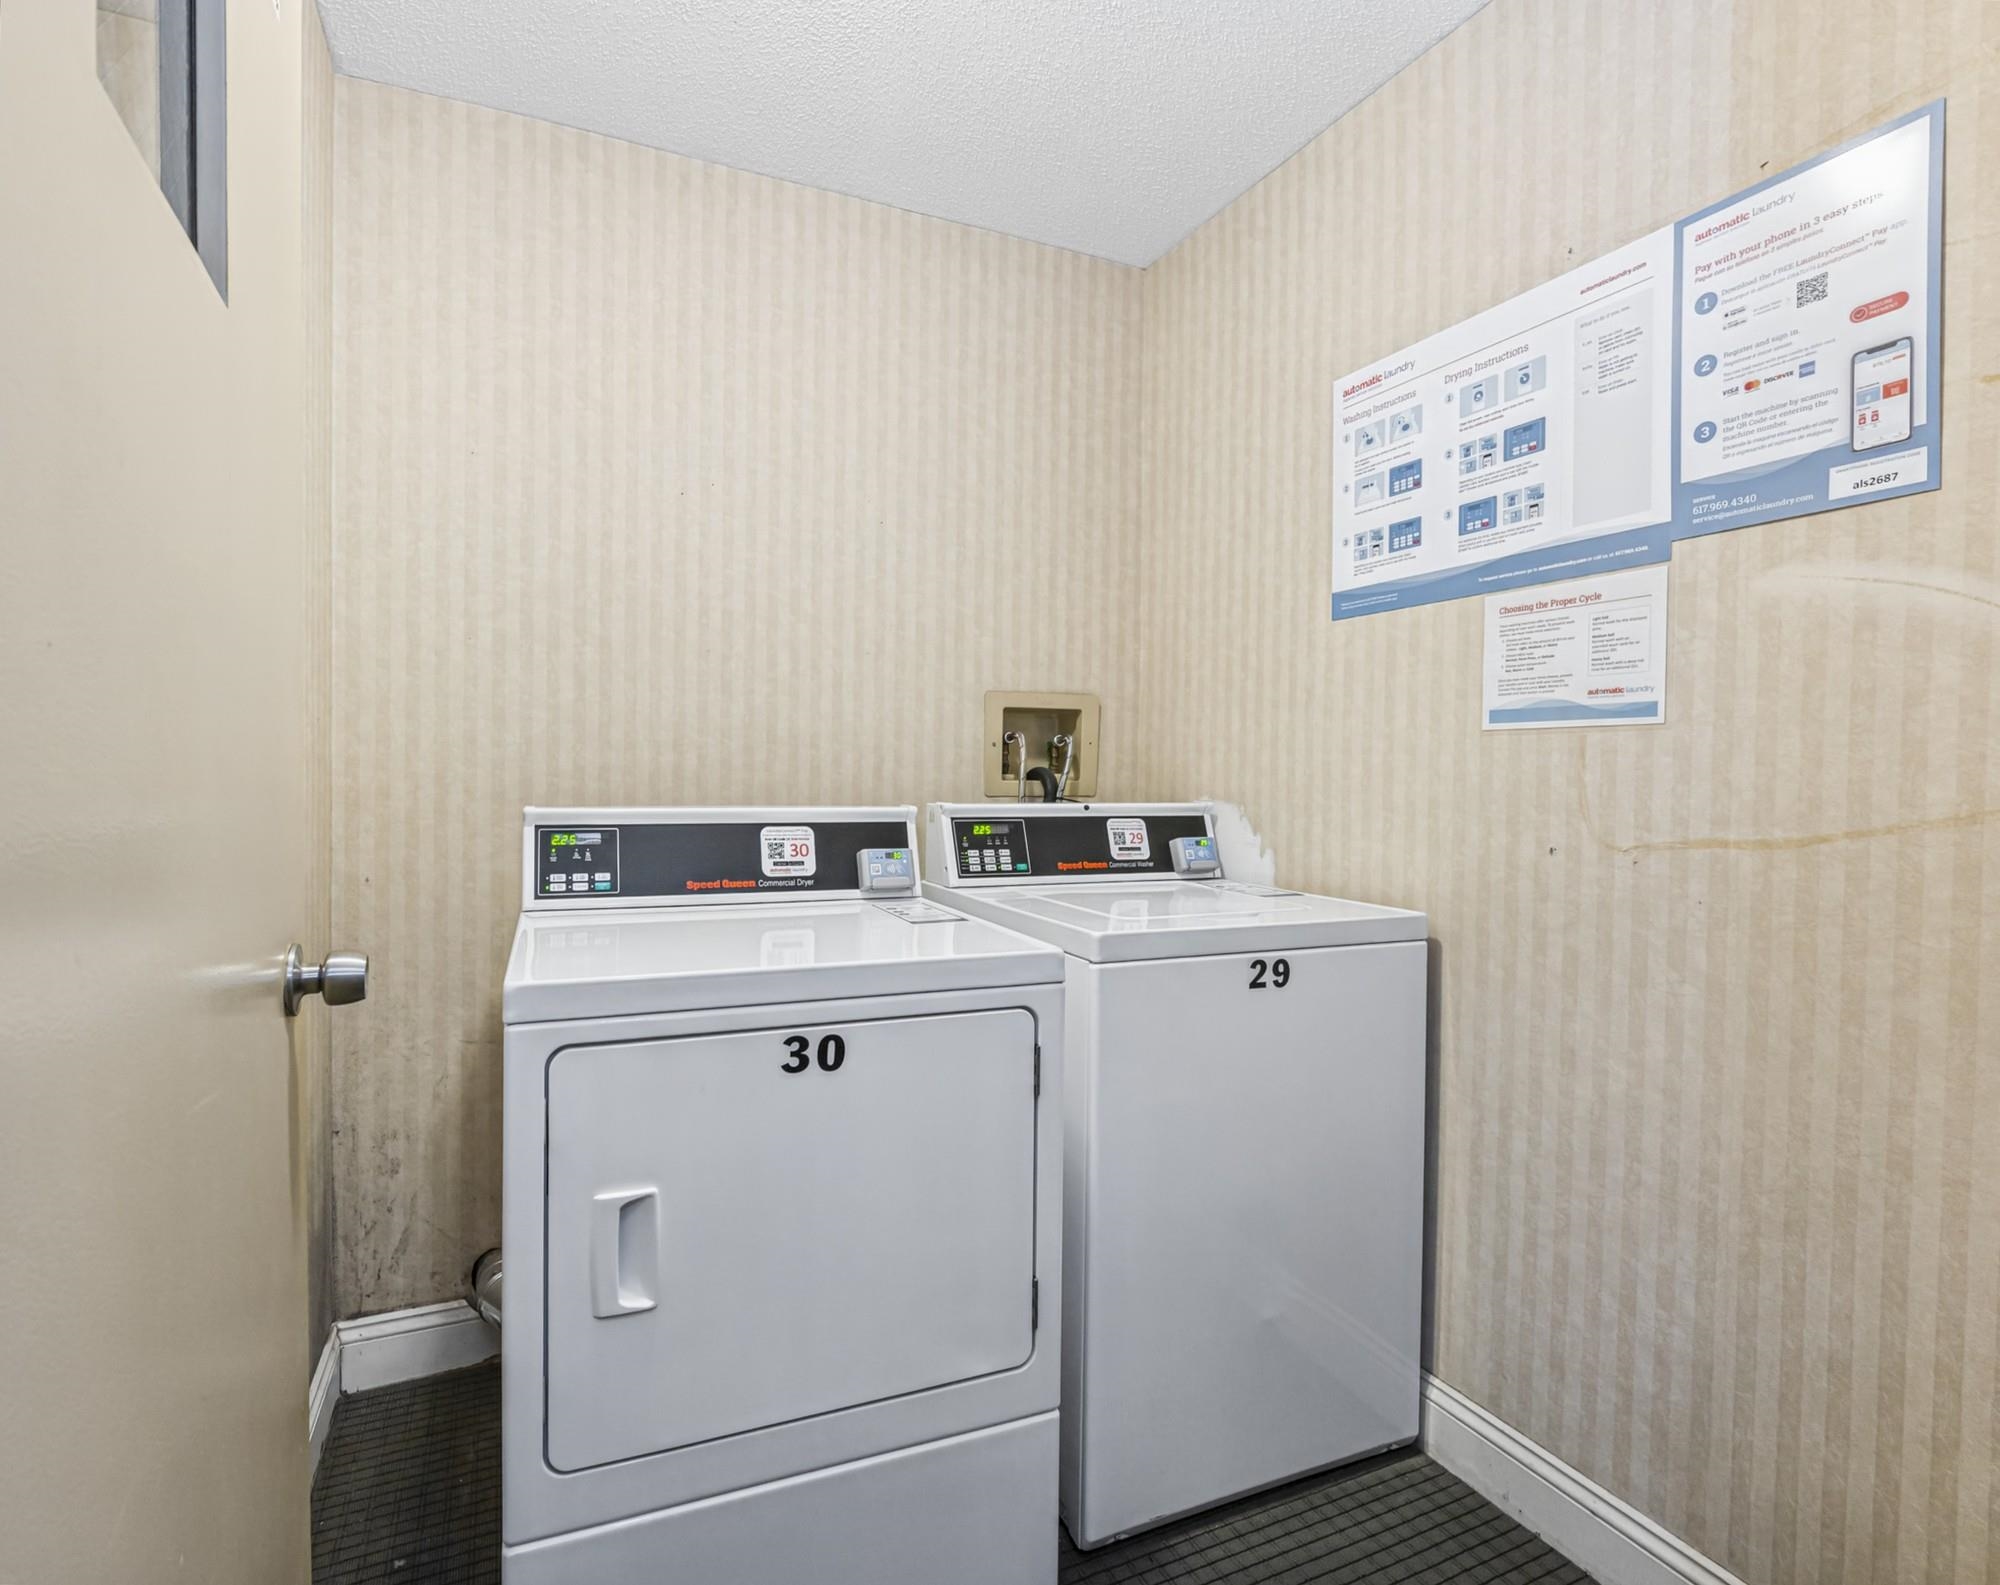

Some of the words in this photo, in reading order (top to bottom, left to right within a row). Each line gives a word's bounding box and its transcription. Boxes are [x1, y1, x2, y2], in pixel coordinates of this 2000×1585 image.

[1695, 212, 1750, 242] automatic
[1752, 192, 1796, 217] laundry
[1695, 262, 1713, 275] Pay
[1714, 252, 1737, 266] with
[1739, 242, 1762, 258] your
[1765, 227, 1797, 248] phone
[1799, 222, 1811, 232] in
[1813, 216, 1821, 226] 3
[1822, 205, 1849, 222] easy
[1580, 262, 1647, 295] automaticlaundry.com
[1444, 367, 1473, 385] Drying
[1474, 344, 1529, 373] Instructions
[1343, 374, 1383, 398] automatic
[1384, 360, 1416, 380] laundry
[1343, 408, 1372, 426] Washing
[1373, 390, 1417, 414] Instructions
[1722, 415, 1740, 425] Start
[1741, 412, 1754, 420] the
[1723, 425, 1735, 433] the
[1748, 416, 1768, 426] Code
[1815, 400, 1829, 408] the
[1701, 427, 1709, 438] 3
[1852, 472, 1898, 489] als2687
[1692, 494, 1757, 515] 617.969.4340
[1499, 604, 1534, 615] Choosing
[1535, 601, 1549, 609] the
[1550, 597, 1577, 607] Proper
[1579, 592, 1602, 603] Cycle
[1587, 687, 1625, 695] automatic
[1626, 685, 1655, 693] laundry
[551, 834, 576, 846] 2.25
[1129, 832, 1144, 844] 29
[790, 843, 809, 858] 30
[686, 880, 720, 890] Speed
[721, 879, 756, 889] Queen
[758, 879, 795, 887] Commercial
[796, 878, 814, 887] Dryer
[1248, 958, 1291, 989] 29
[780, 1034, 846, 1074] 30
